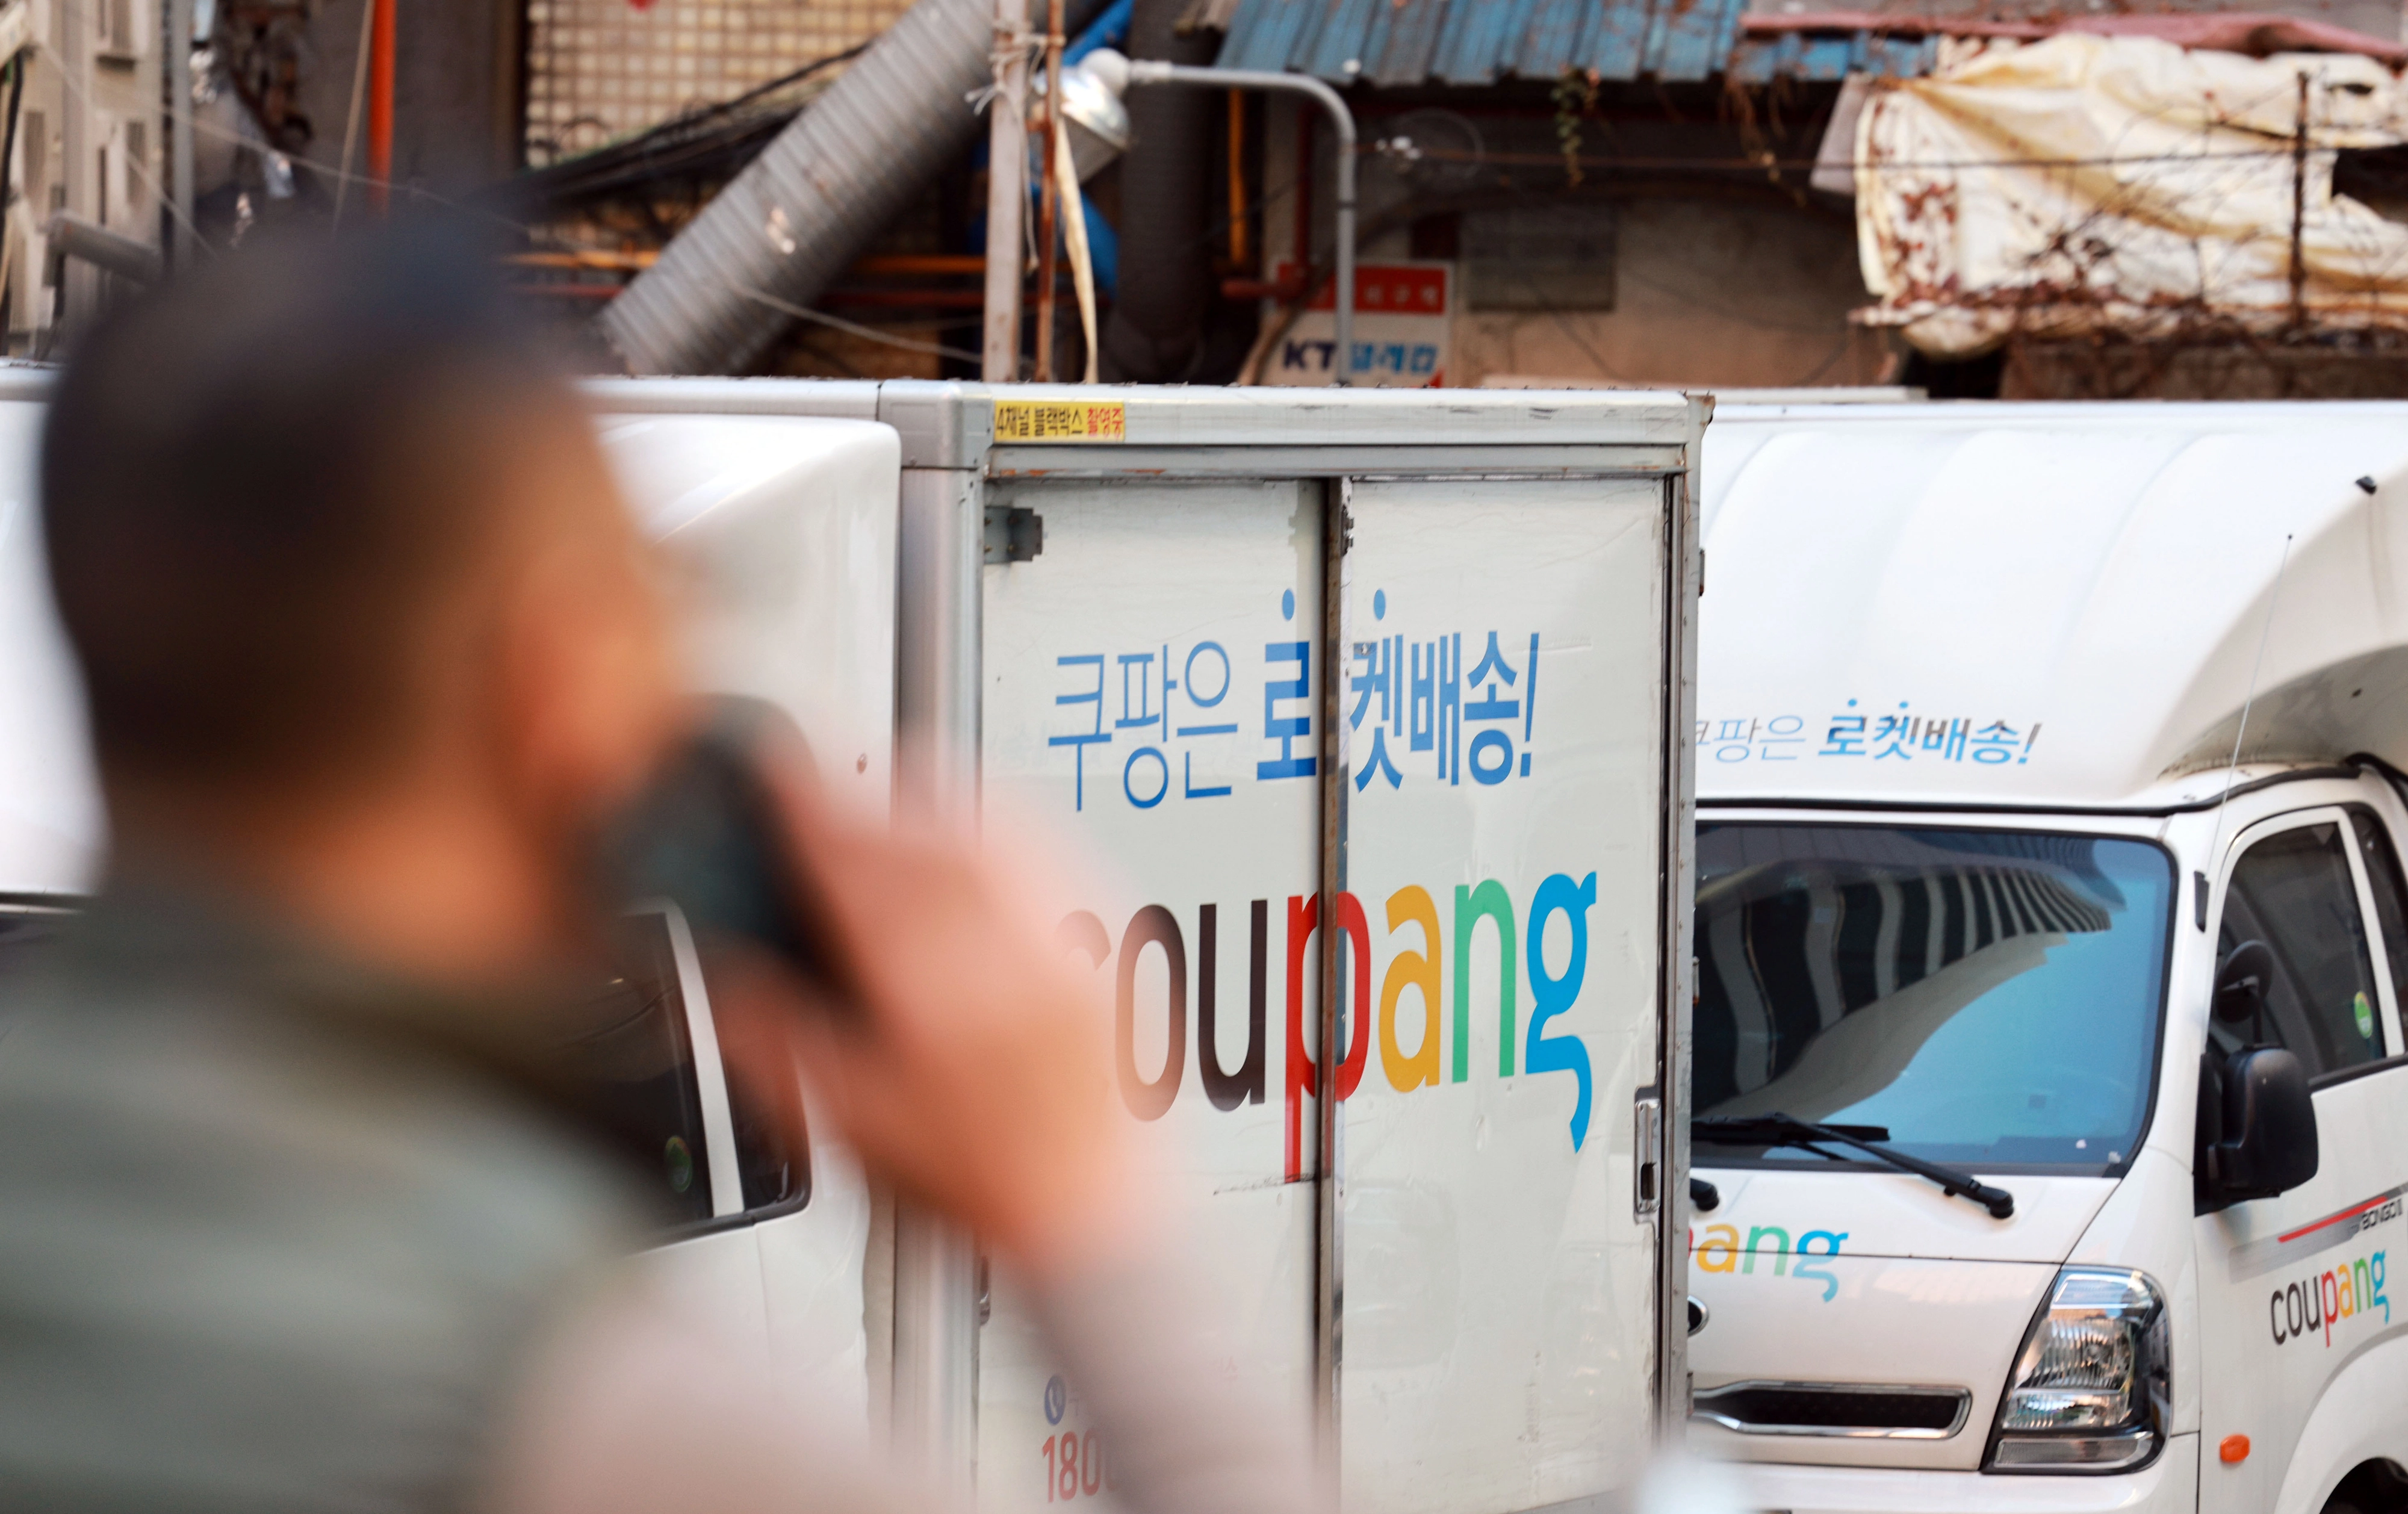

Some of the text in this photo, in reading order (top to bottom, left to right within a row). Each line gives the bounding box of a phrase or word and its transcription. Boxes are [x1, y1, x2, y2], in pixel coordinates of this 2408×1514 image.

[996, 405, 1123, 439] 4채널 블랙박스 촬영중
[1048, 588, 1540, 812] 쿠팡은 로켓배송!
[1817, 698, 2043, 765] 로켓배송!
[1688, 1223, 1849, 1303] ang
[2270, 1249, 2391, 1348] coupang
